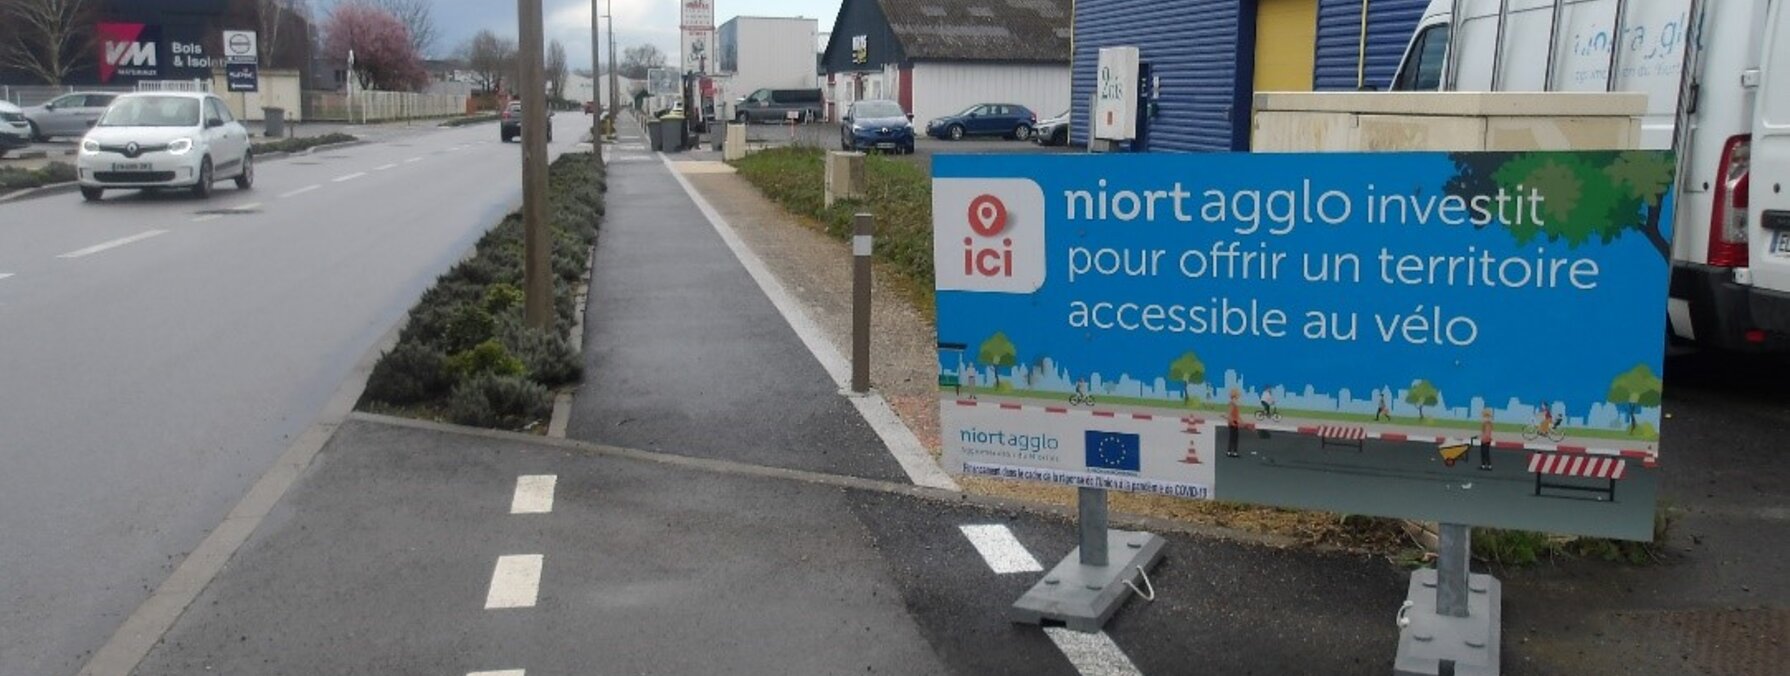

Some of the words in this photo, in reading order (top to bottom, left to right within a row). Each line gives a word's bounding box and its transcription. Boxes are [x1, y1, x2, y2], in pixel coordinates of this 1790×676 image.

[105, 41, 156, 66] VM
[171, 41, 202, 54] Bois
[173, 55, 183, 67] &
[1064, 178, 1192, 222] niort
[1201, 178, 1351, 235] agglo
[1367, 184, 1545, 226] investit
[963, 237, 1013, 277] ici
[1068, 247, 1166, 282] pour
[1179, 241, 1286, 280] offrir
[1303, 252, 1360, 283] un
[1378, 245, 1600, 290] territoire
[1068, 297, 1287, 338] accessible
[1303, 310, 1358, 341] au
[1375, 305, 1478, 346] vélo
[960, 427, 1005, 446] niort
[1007, 433, 1059, 453] agglo
[1174, 484, 1208, 498] COVID-19
